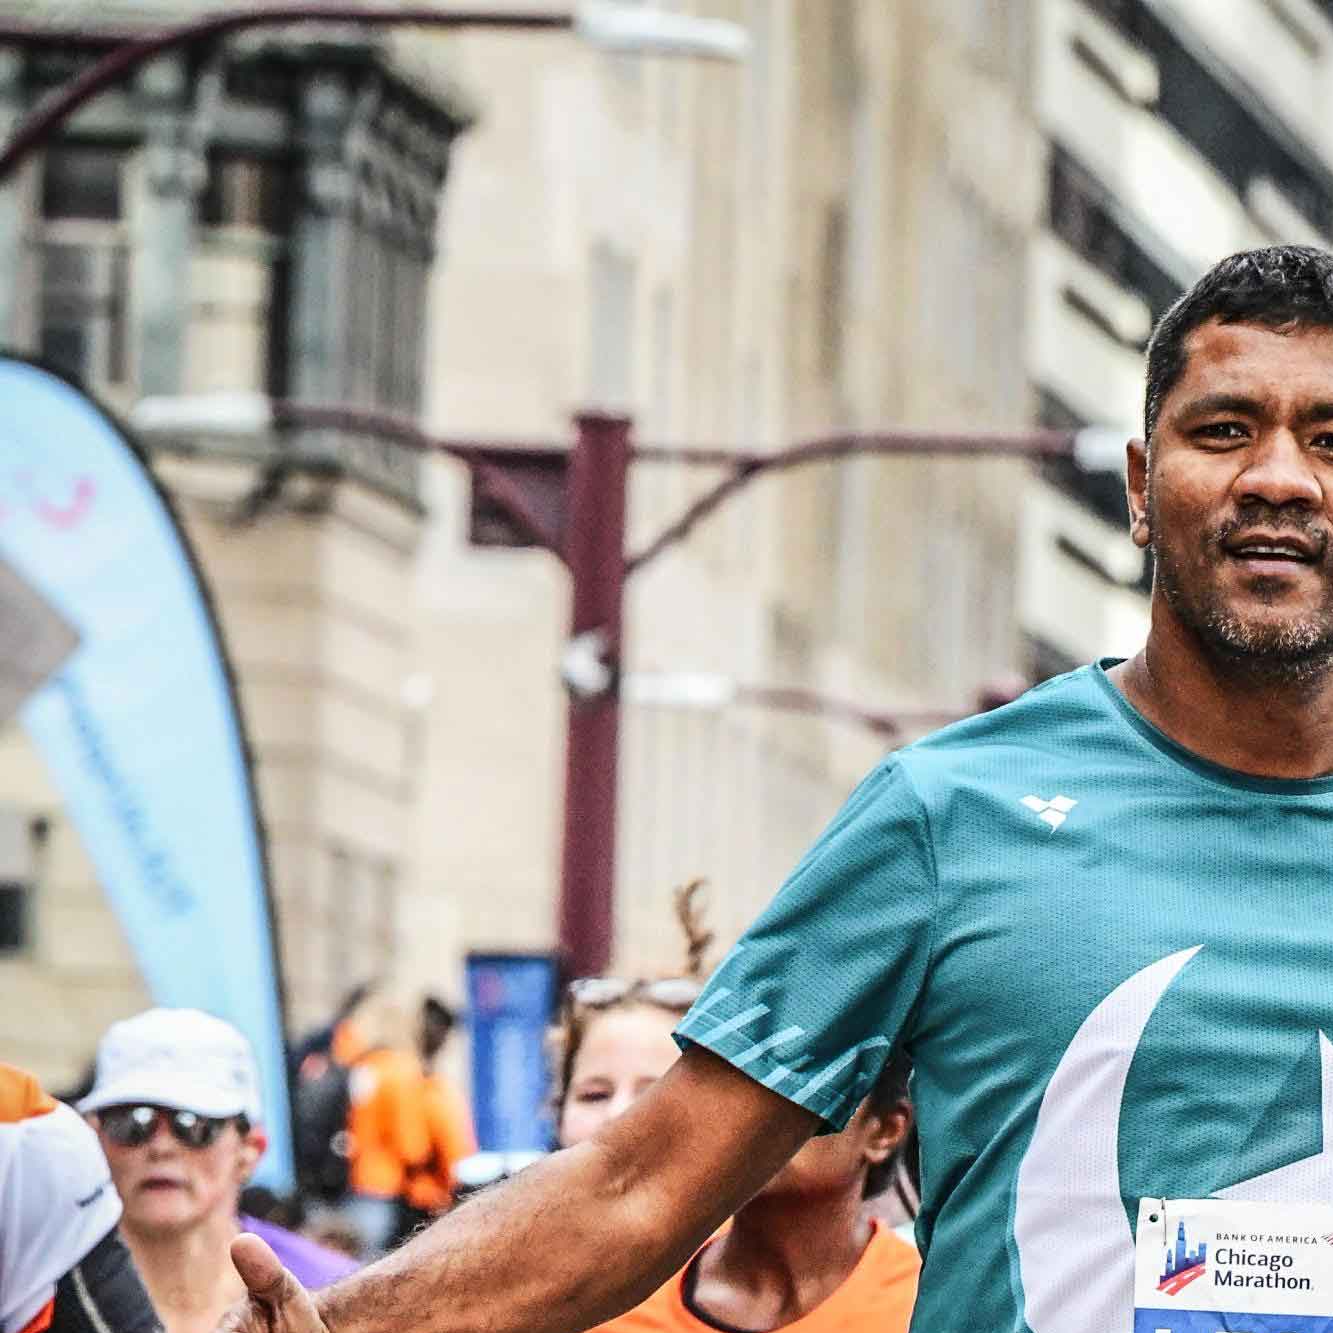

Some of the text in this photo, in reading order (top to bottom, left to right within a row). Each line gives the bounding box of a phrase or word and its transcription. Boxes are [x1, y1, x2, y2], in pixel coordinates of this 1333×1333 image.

[1216, 1233, 1318, 1246] BANK OF AMERICA
[1215, 1248, 1293, 1271] Chicago
[1214, 1270, 1311, 1290] Marathon
